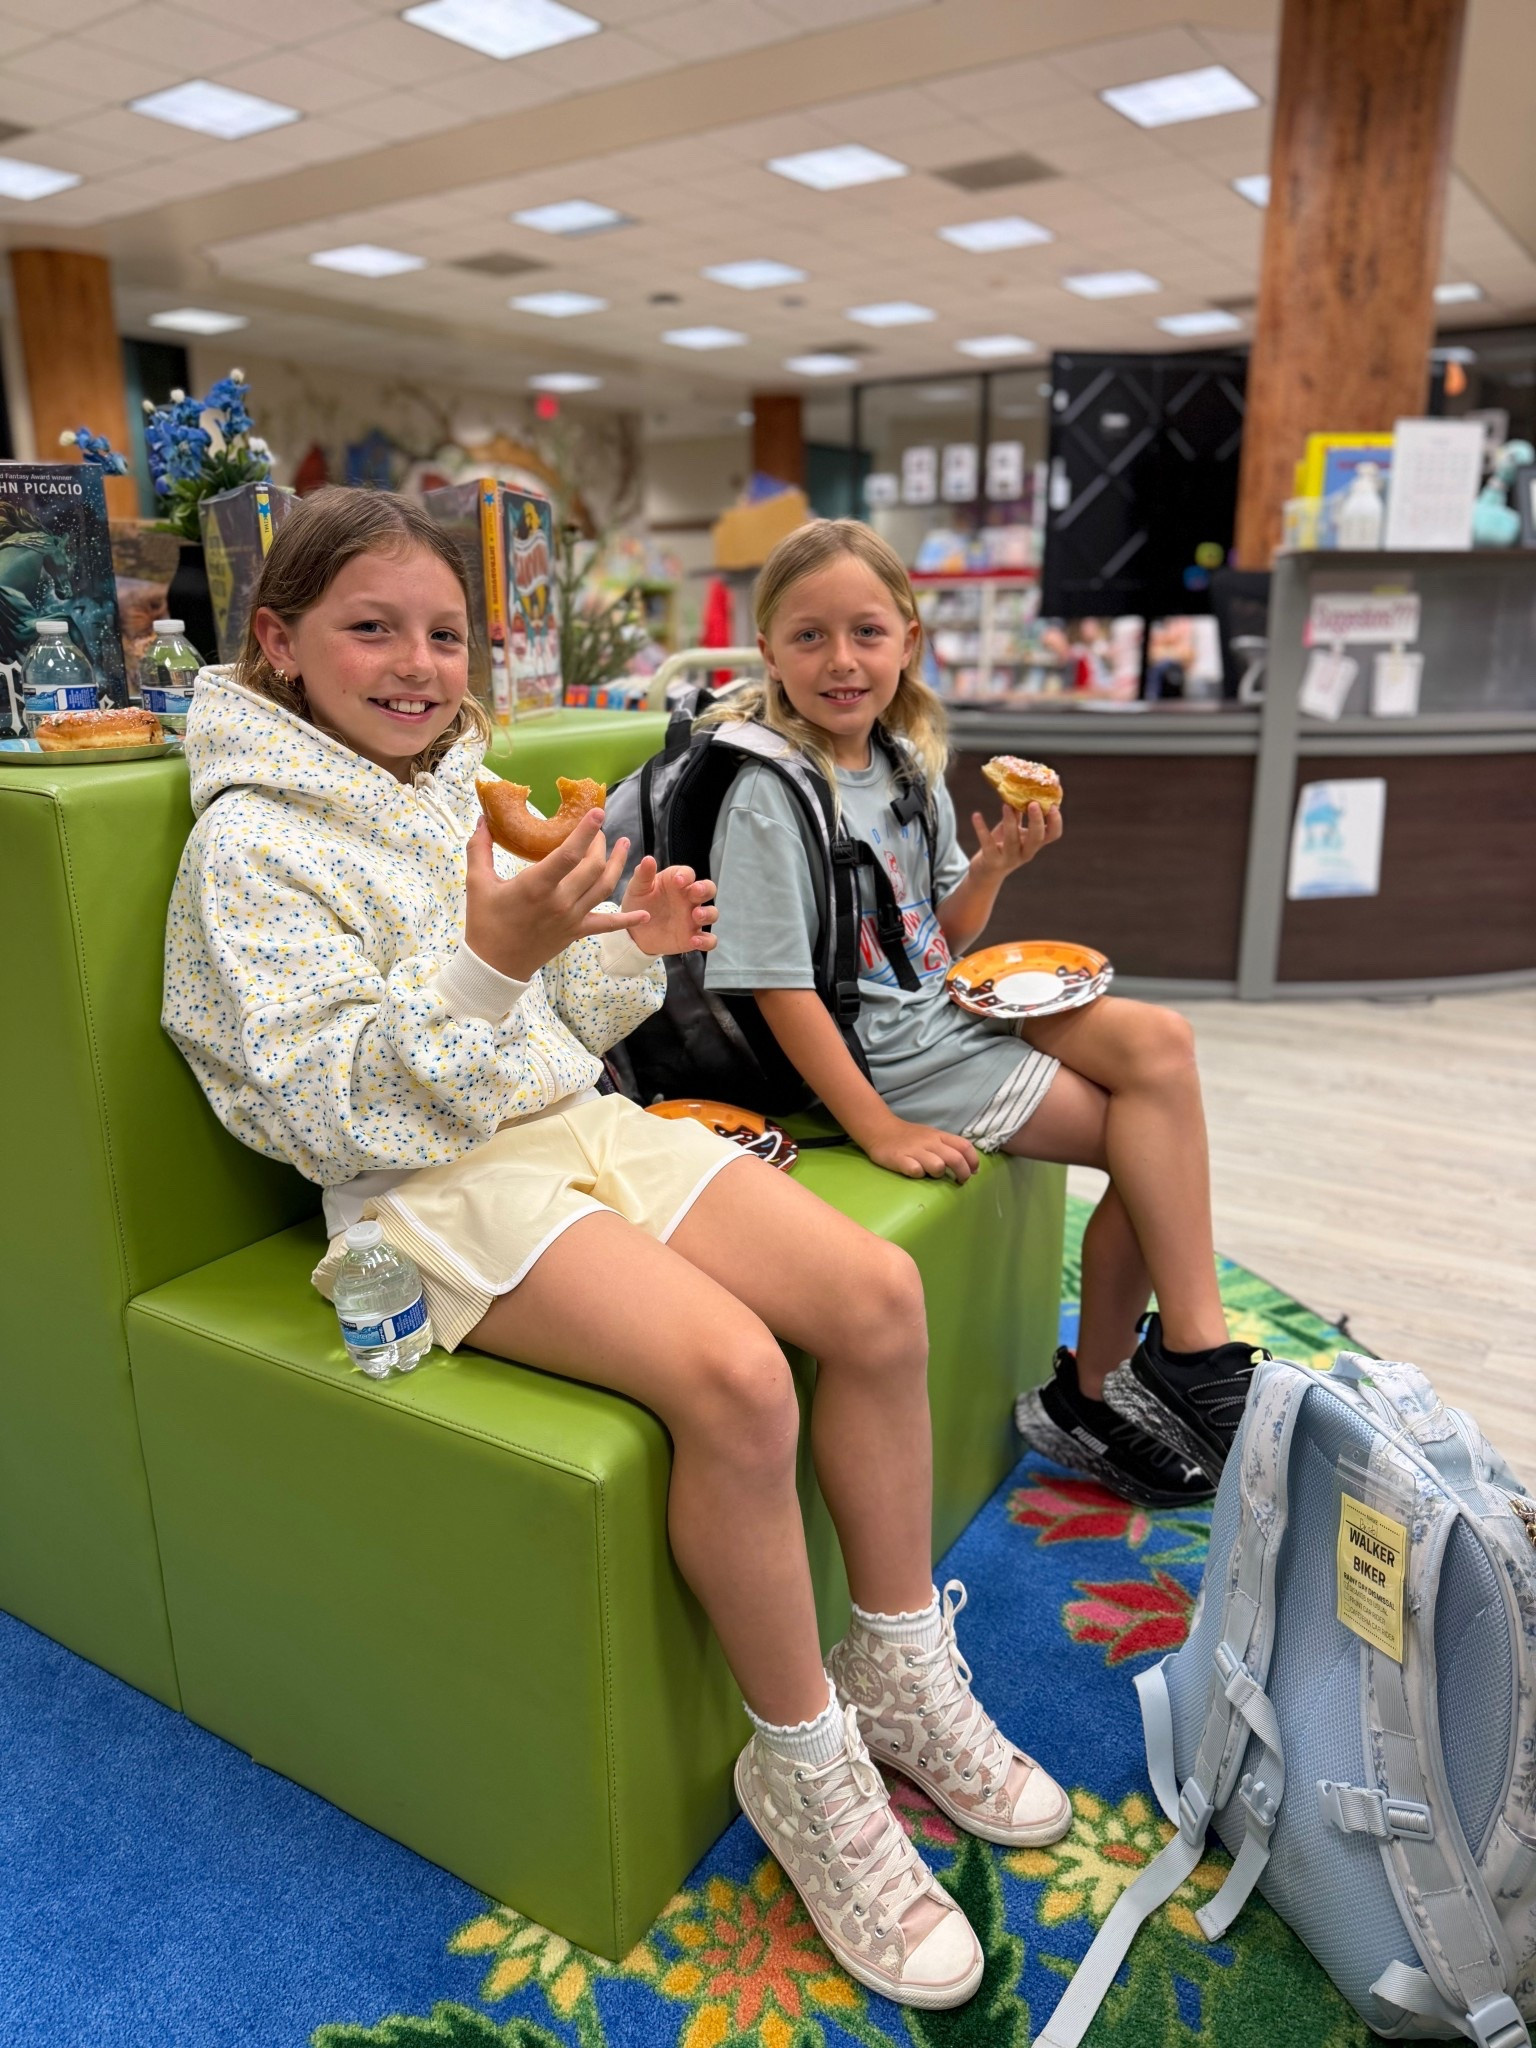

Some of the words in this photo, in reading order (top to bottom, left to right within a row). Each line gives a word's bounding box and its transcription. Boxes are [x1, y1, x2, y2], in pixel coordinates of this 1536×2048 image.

[24, 482, 83, 495] PICACIO
[1071, 1426, 1109, 1455] PUMA
[1349, 1527, 1395, 1568] WALKER
[1353, 1556, 1386, 1588] BIKER
[1368, 1588, 1396, 1611] DISMISSAL
